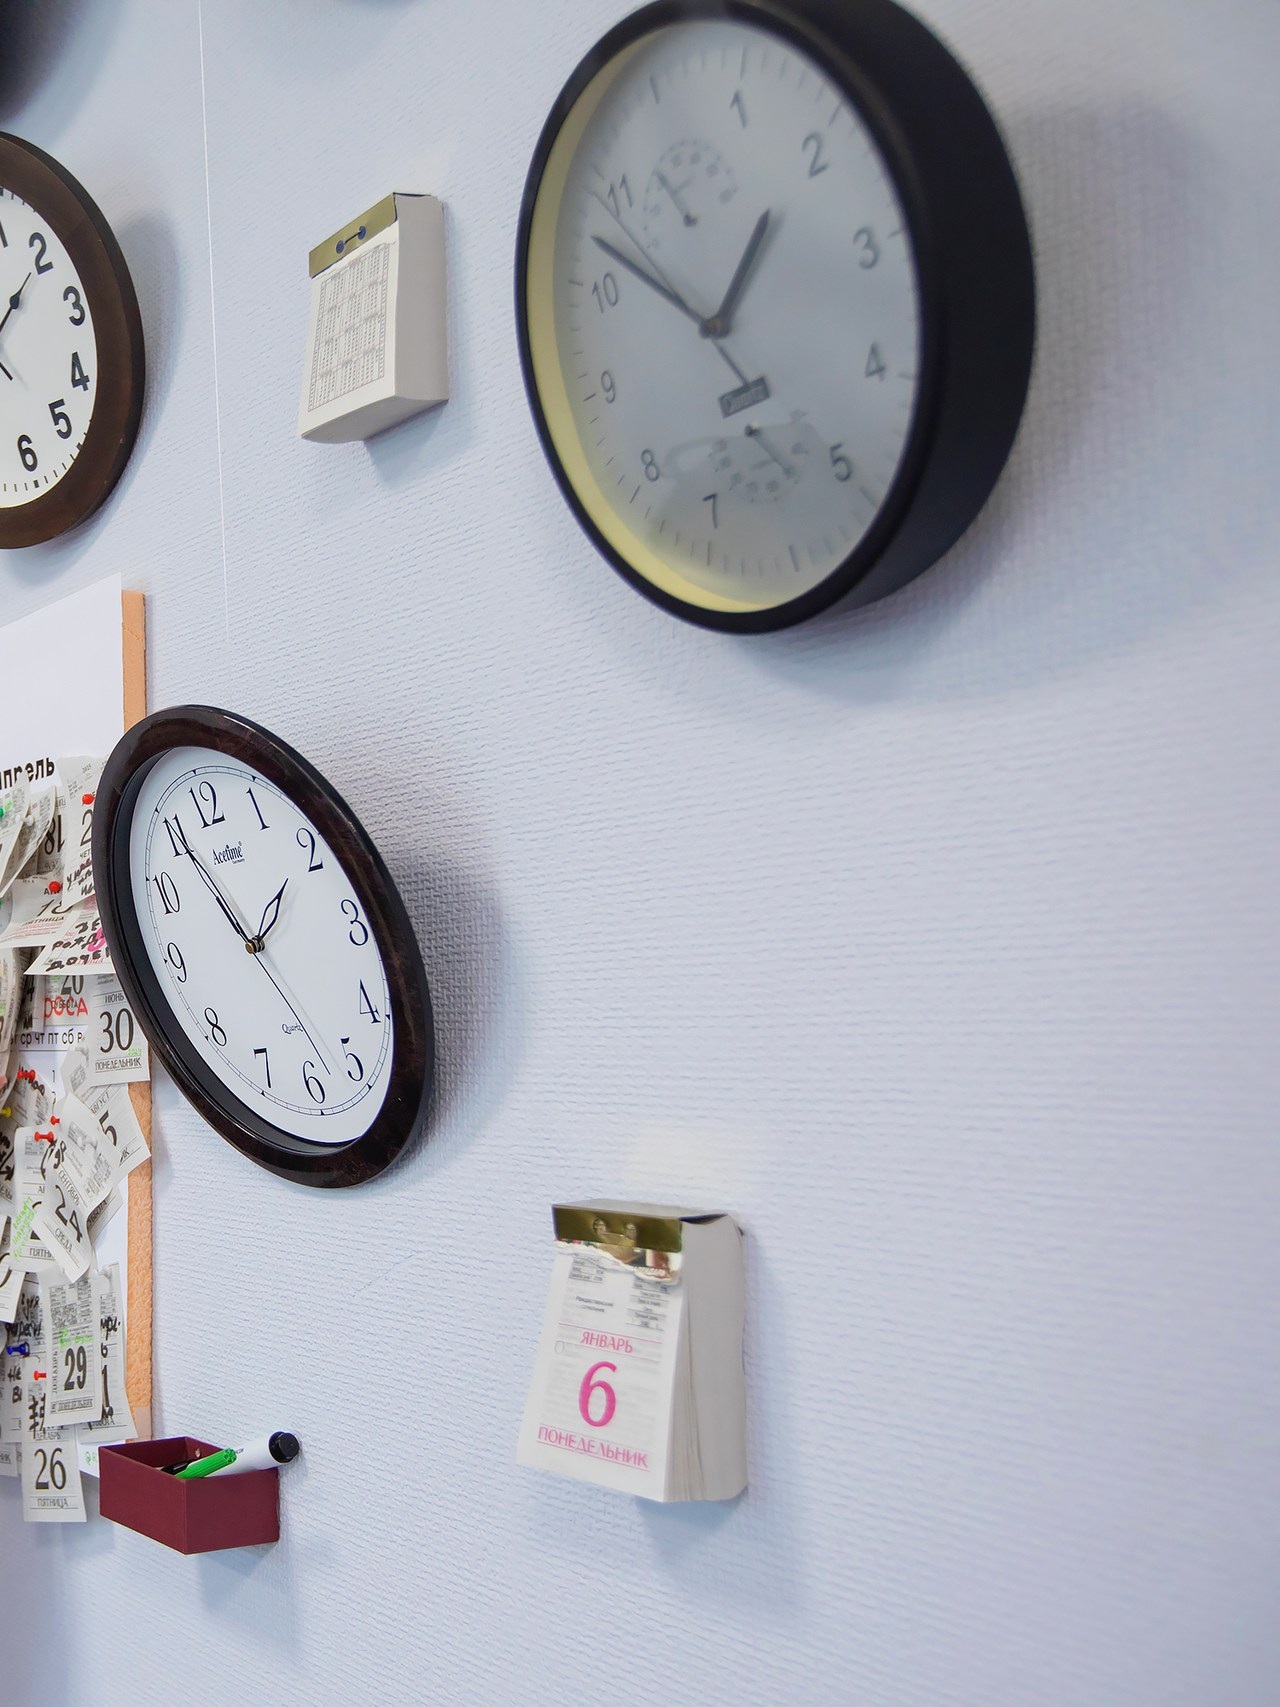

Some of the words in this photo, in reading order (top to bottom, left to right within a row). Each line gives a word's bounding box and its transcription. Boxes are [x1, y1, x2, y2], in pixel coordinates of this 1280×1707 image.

[729, 90, 749, 130] 1
[801, 132, 829, 178] 2
[607, 173, 635, 217] 11
[28, 232, 54, 275] 2
[852, 226, 881, 269] 3
[63, 285, 86, 326] 3
[590, 271, 620, 314] 10
[70, 351, 91, 392] 4
[864, 343, 887, 382] 4
[600, 371, 617, 404] 9
[47, 398, 72, 439] 5
[17, 434, 38, 472] 6
[640, 448, 662, 484] 8
[830, 444, 853, 483] 5
[703, 493, 720, 529] 7
[188, 781, 227, 829] 12
[245, 787, 271, 831] 1
[162, 814, 194, 859] 11
[296, 827, 324, 873] 2
[152, 871, 182, 915] 10
[340, 899, 369, 947] 3
[167, 942, 188, 983] 9
[105, 992, 125, 1004] ИЮНЬ
[358, 979, 381, 1025] 4
[20, 1035, 32, 1049] ср
[35, 1032, 45, 1045] чт
[48, 1032, 59, 1044] пт
[61, 1027, 74, 1045] сб
[100, 1007, 134, 1054] 30
[203, 1006, 228, 1047] 8
[95, 1057, 142, 1071] ПОНЕДЕЛЬНИК
[253, 1047, 273, 1089] 7
[340, 1037, 365, 1082] 5
[301, 1060, 326, 1105] 6
[59, 1169, 80, 1206] СЕНТЯБРЬ
[55, 1184, 83, 1244] 24
[29, 1246, 53, 1259] ПЯТН
[54, 1227, 74, 1253] СРЕДА
[580, 1331, 634, 1354] ЯНВАРЬ
[64, 1345, 87, 1391] 29
[578, 1361, 618, 1428] 6
[537, 1426, 650, 1469] ПОНЕДЕЛЬНИК
[34, 1447, 67, 1491] 26
[37, 1498, 69, 1509] ПЯТНИЦА
